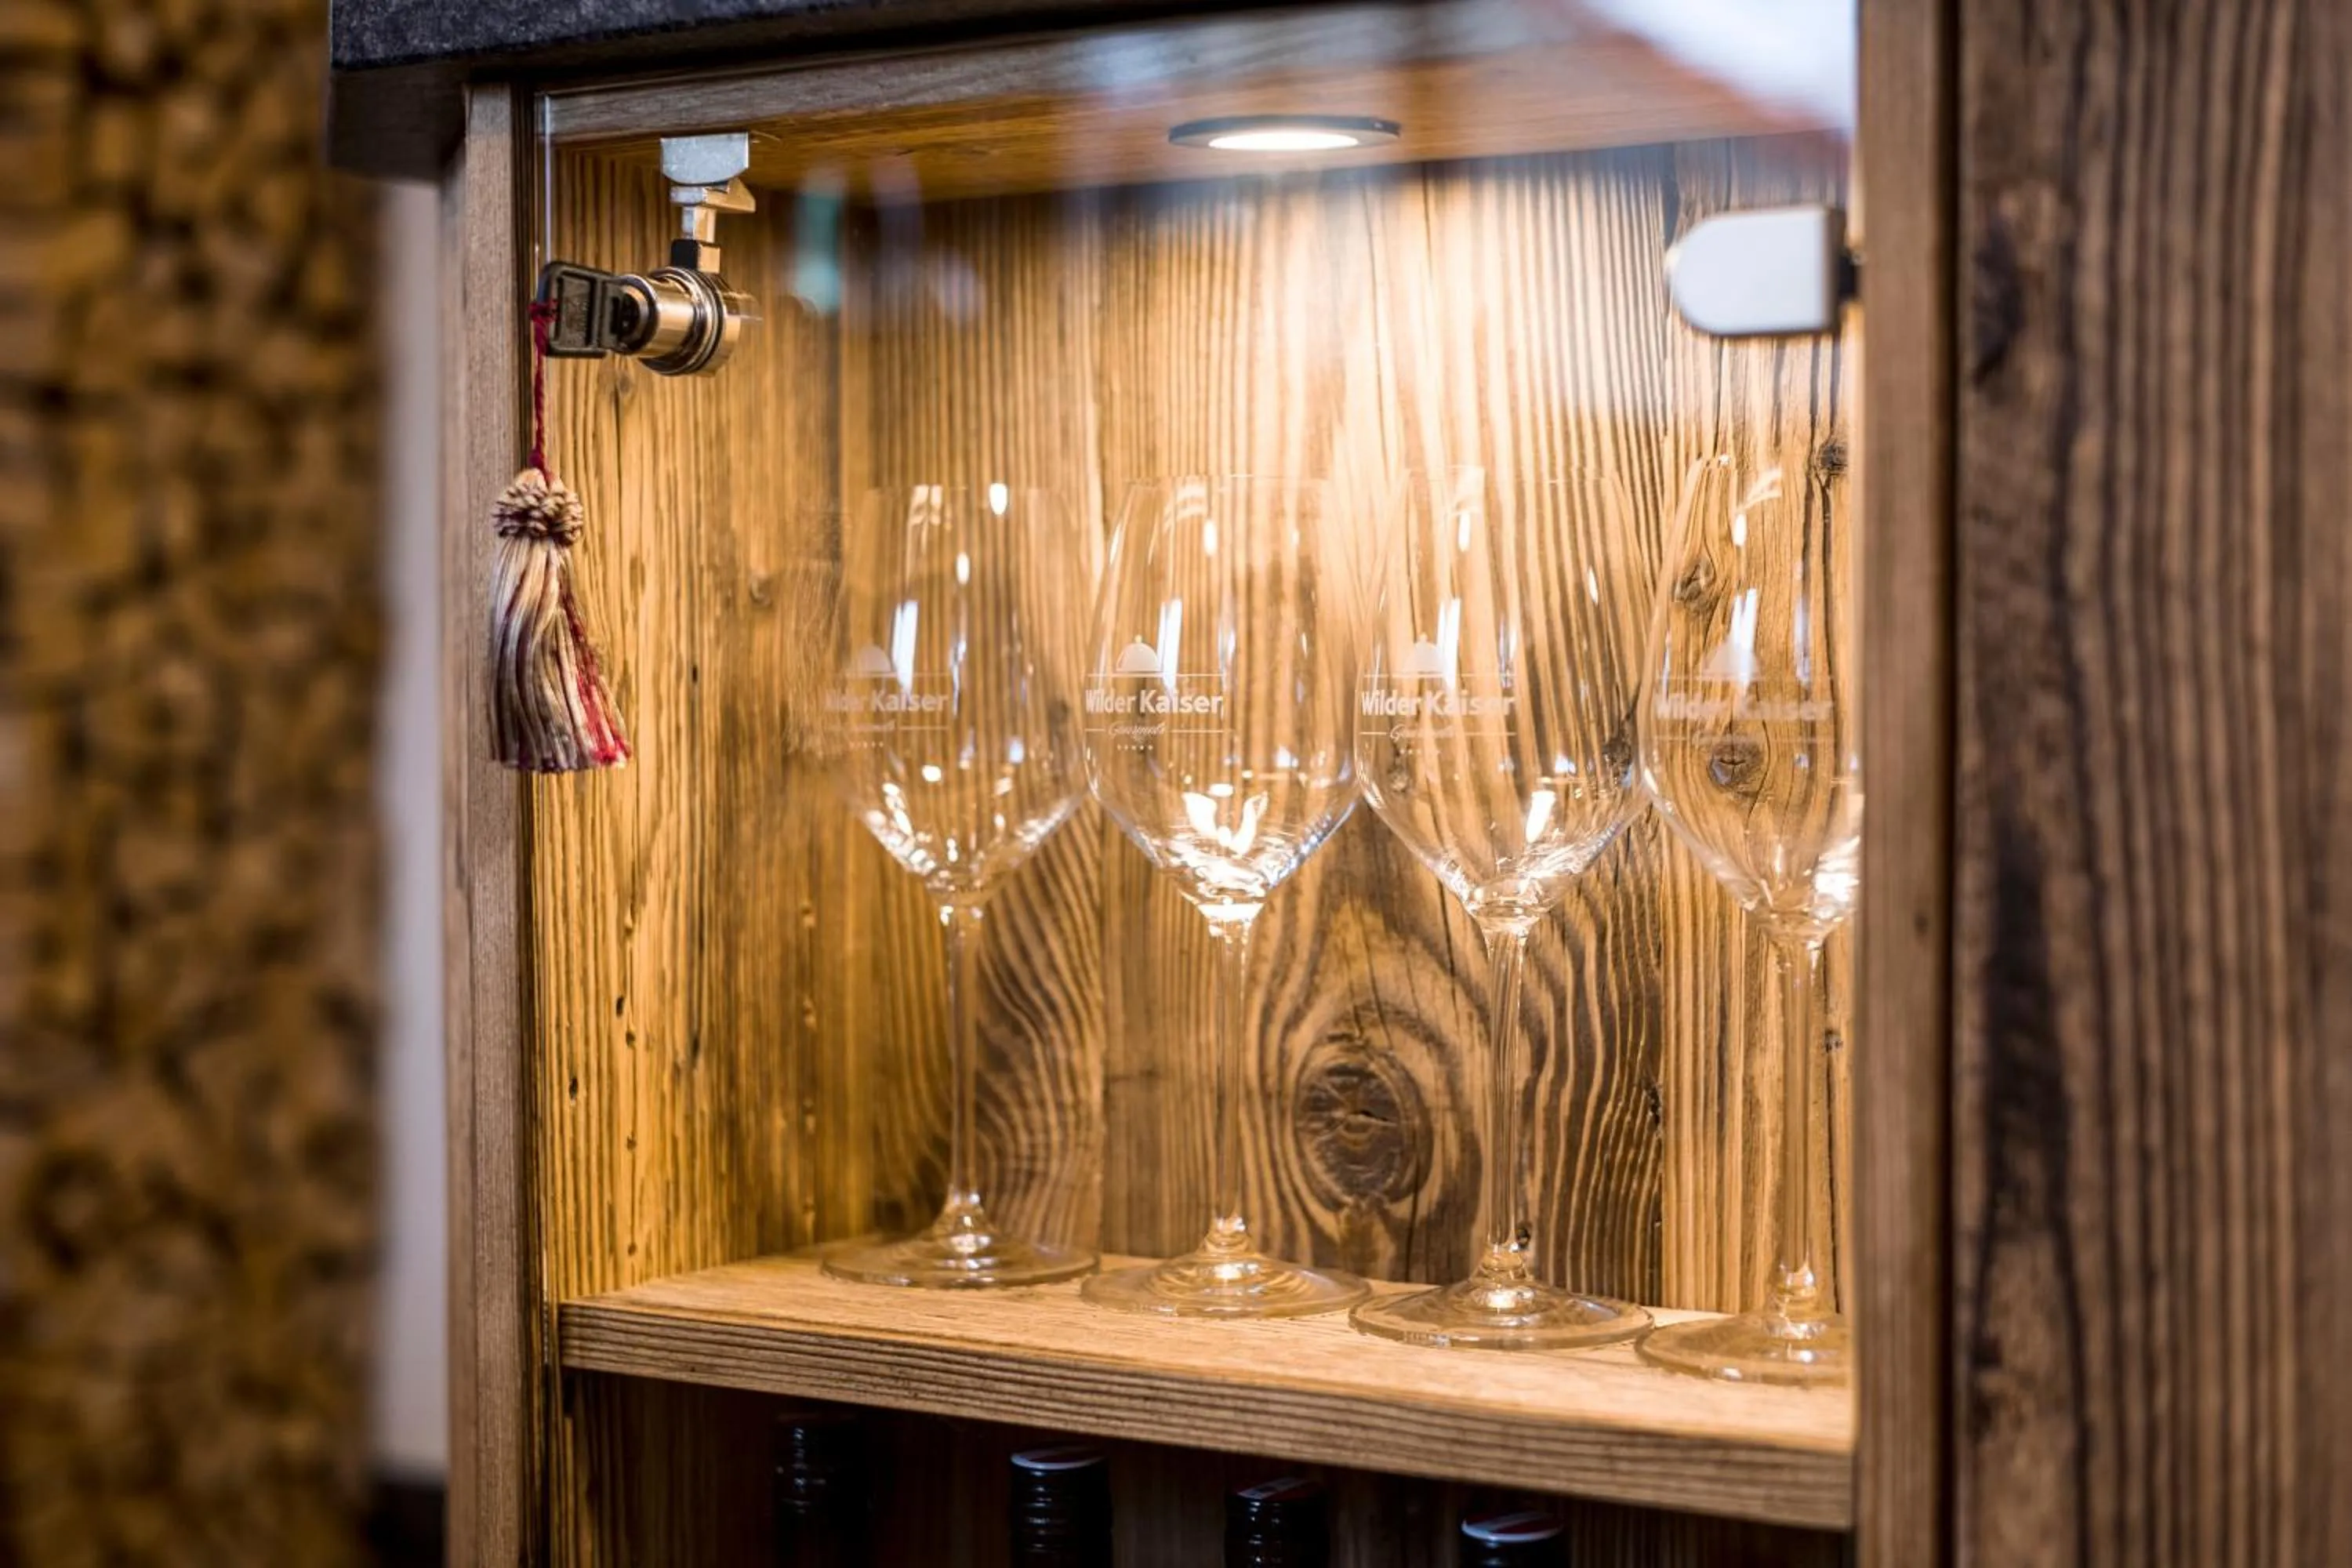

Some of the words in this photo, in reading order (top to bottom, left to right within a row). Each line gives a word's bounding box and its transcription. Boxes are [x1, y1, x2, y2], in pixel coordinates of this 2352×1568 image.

[873, 689, 949, 713] Kaiser
[1085, 689, 1137, 714] Wilder
[1139, 689, 1223, 714] Kaiser
[1362, 688, 1421, 717] Wilder
[1424, 688, 1516, 717] Kaiser
